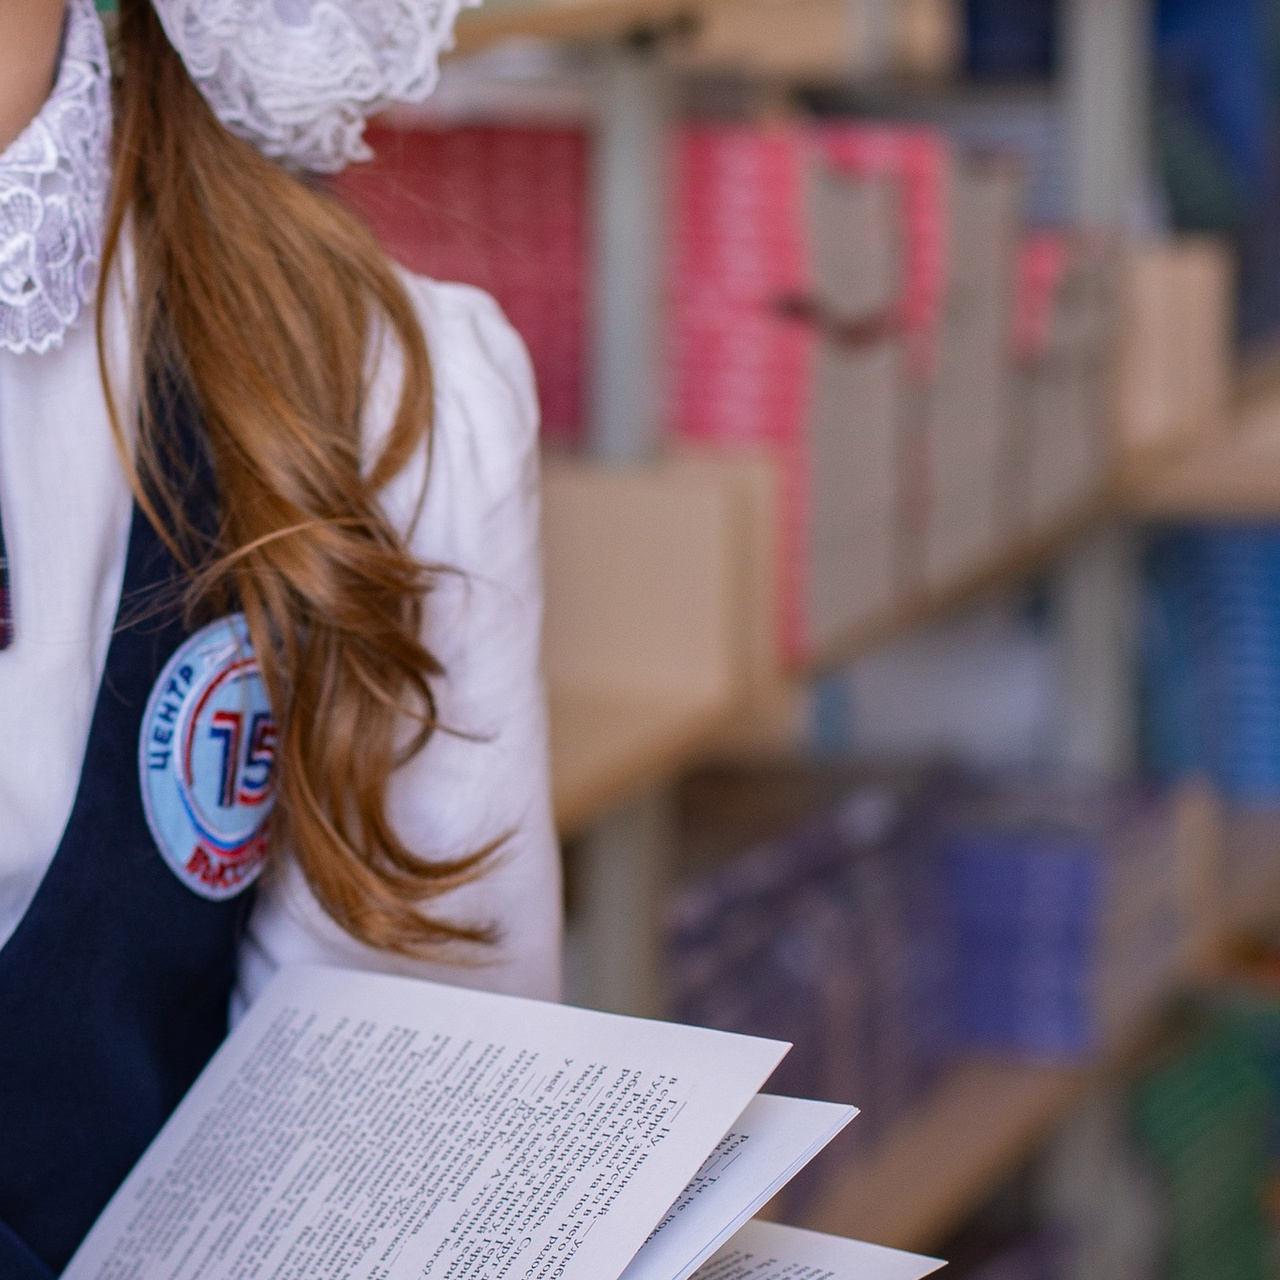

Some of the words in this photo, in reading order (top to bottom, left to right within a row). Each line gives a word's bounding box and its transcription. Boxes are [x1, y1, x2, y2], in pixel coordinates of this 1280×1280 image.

[147, 664, 194, 771] ЦЕНТР
[209, 710, 277, 807] 75
[518, 1052, 539, 1075] что
[565, 1064, 595, 1097] твои,
[544, 1070, 564, 1093] неё
[561, 1065, 607, 1120] мечтала
[605, 1068, 631, 1098] роге
[632, 1074, 666, 1114] гуляй
[481, 1077, 519, 1127] сказал?
[504, 1099, 529, 1127] Для
[540, 1100, 569, 1128] Рон,
[578, 1102, 605, 1132] вниз
[586, 1070, 642, 1140] обитатели
[617, 1092, 641, 1116] Рон
[632, 1088, 668, 1130] стену,
[641, 1099, 677, 1139] Гарри
[472, 1097, 519, 1150] Смотри,
[500, 1106, 536, 1148] руках.
[502, 1105, 553, 1163] Пустяки.
[538, 1111, 586, 1169] Спасибо
[546, 1124, 561, 1141] об
[608, 1120, 618, 1129] и
[646, 1127, 670, 1148] Ну,
[557, 1136, 579, 1161] они
[575, 1133, 611, 1172] Гарри
[591, 1117, 633, 1167] смело».
[605, 1134, 634, 1168] упал
[426, 1129, 479, 1197] «Кикимер
[448, 1130, 507, 1203] Кикимера!
[448, 1153, 474, 1184] если
[490, 1168, 501, 1179] А
[518, 1146, 546, 1177] этой
[591, 1143, 642, 1204] запустил
[450, 1132, 542, 1250] необыкновенные.
[471, 1184, 491, 1206] это
[517, 1144, 587, 1232] поздравляют
[524, 1173, 539, 1186] за
[589, 1173, 605, 1189] на
[697, 1176, 720, 1192] Ты
[476, 1181, 518, 1234] «Новой
[488, 1190, 525, 1233] книгу,
[500, 1165, 557, 1235] встретили
[529, 1175, 576, 1232] оделись.
[567, 1193, 590, 1218] пол
[583, 1208, 592, 1216] в
[677, 1197, 695, 1211] не
[379, 1200, 426, 1261] слишком
[450, 1208, 470, 1234] для
[557, 1223, 568, 1232] и
[557, 1220, 583, 1251] него
[422, 1237, 451, 1275] кого?
[491, 1236, 516, 1270] друг
